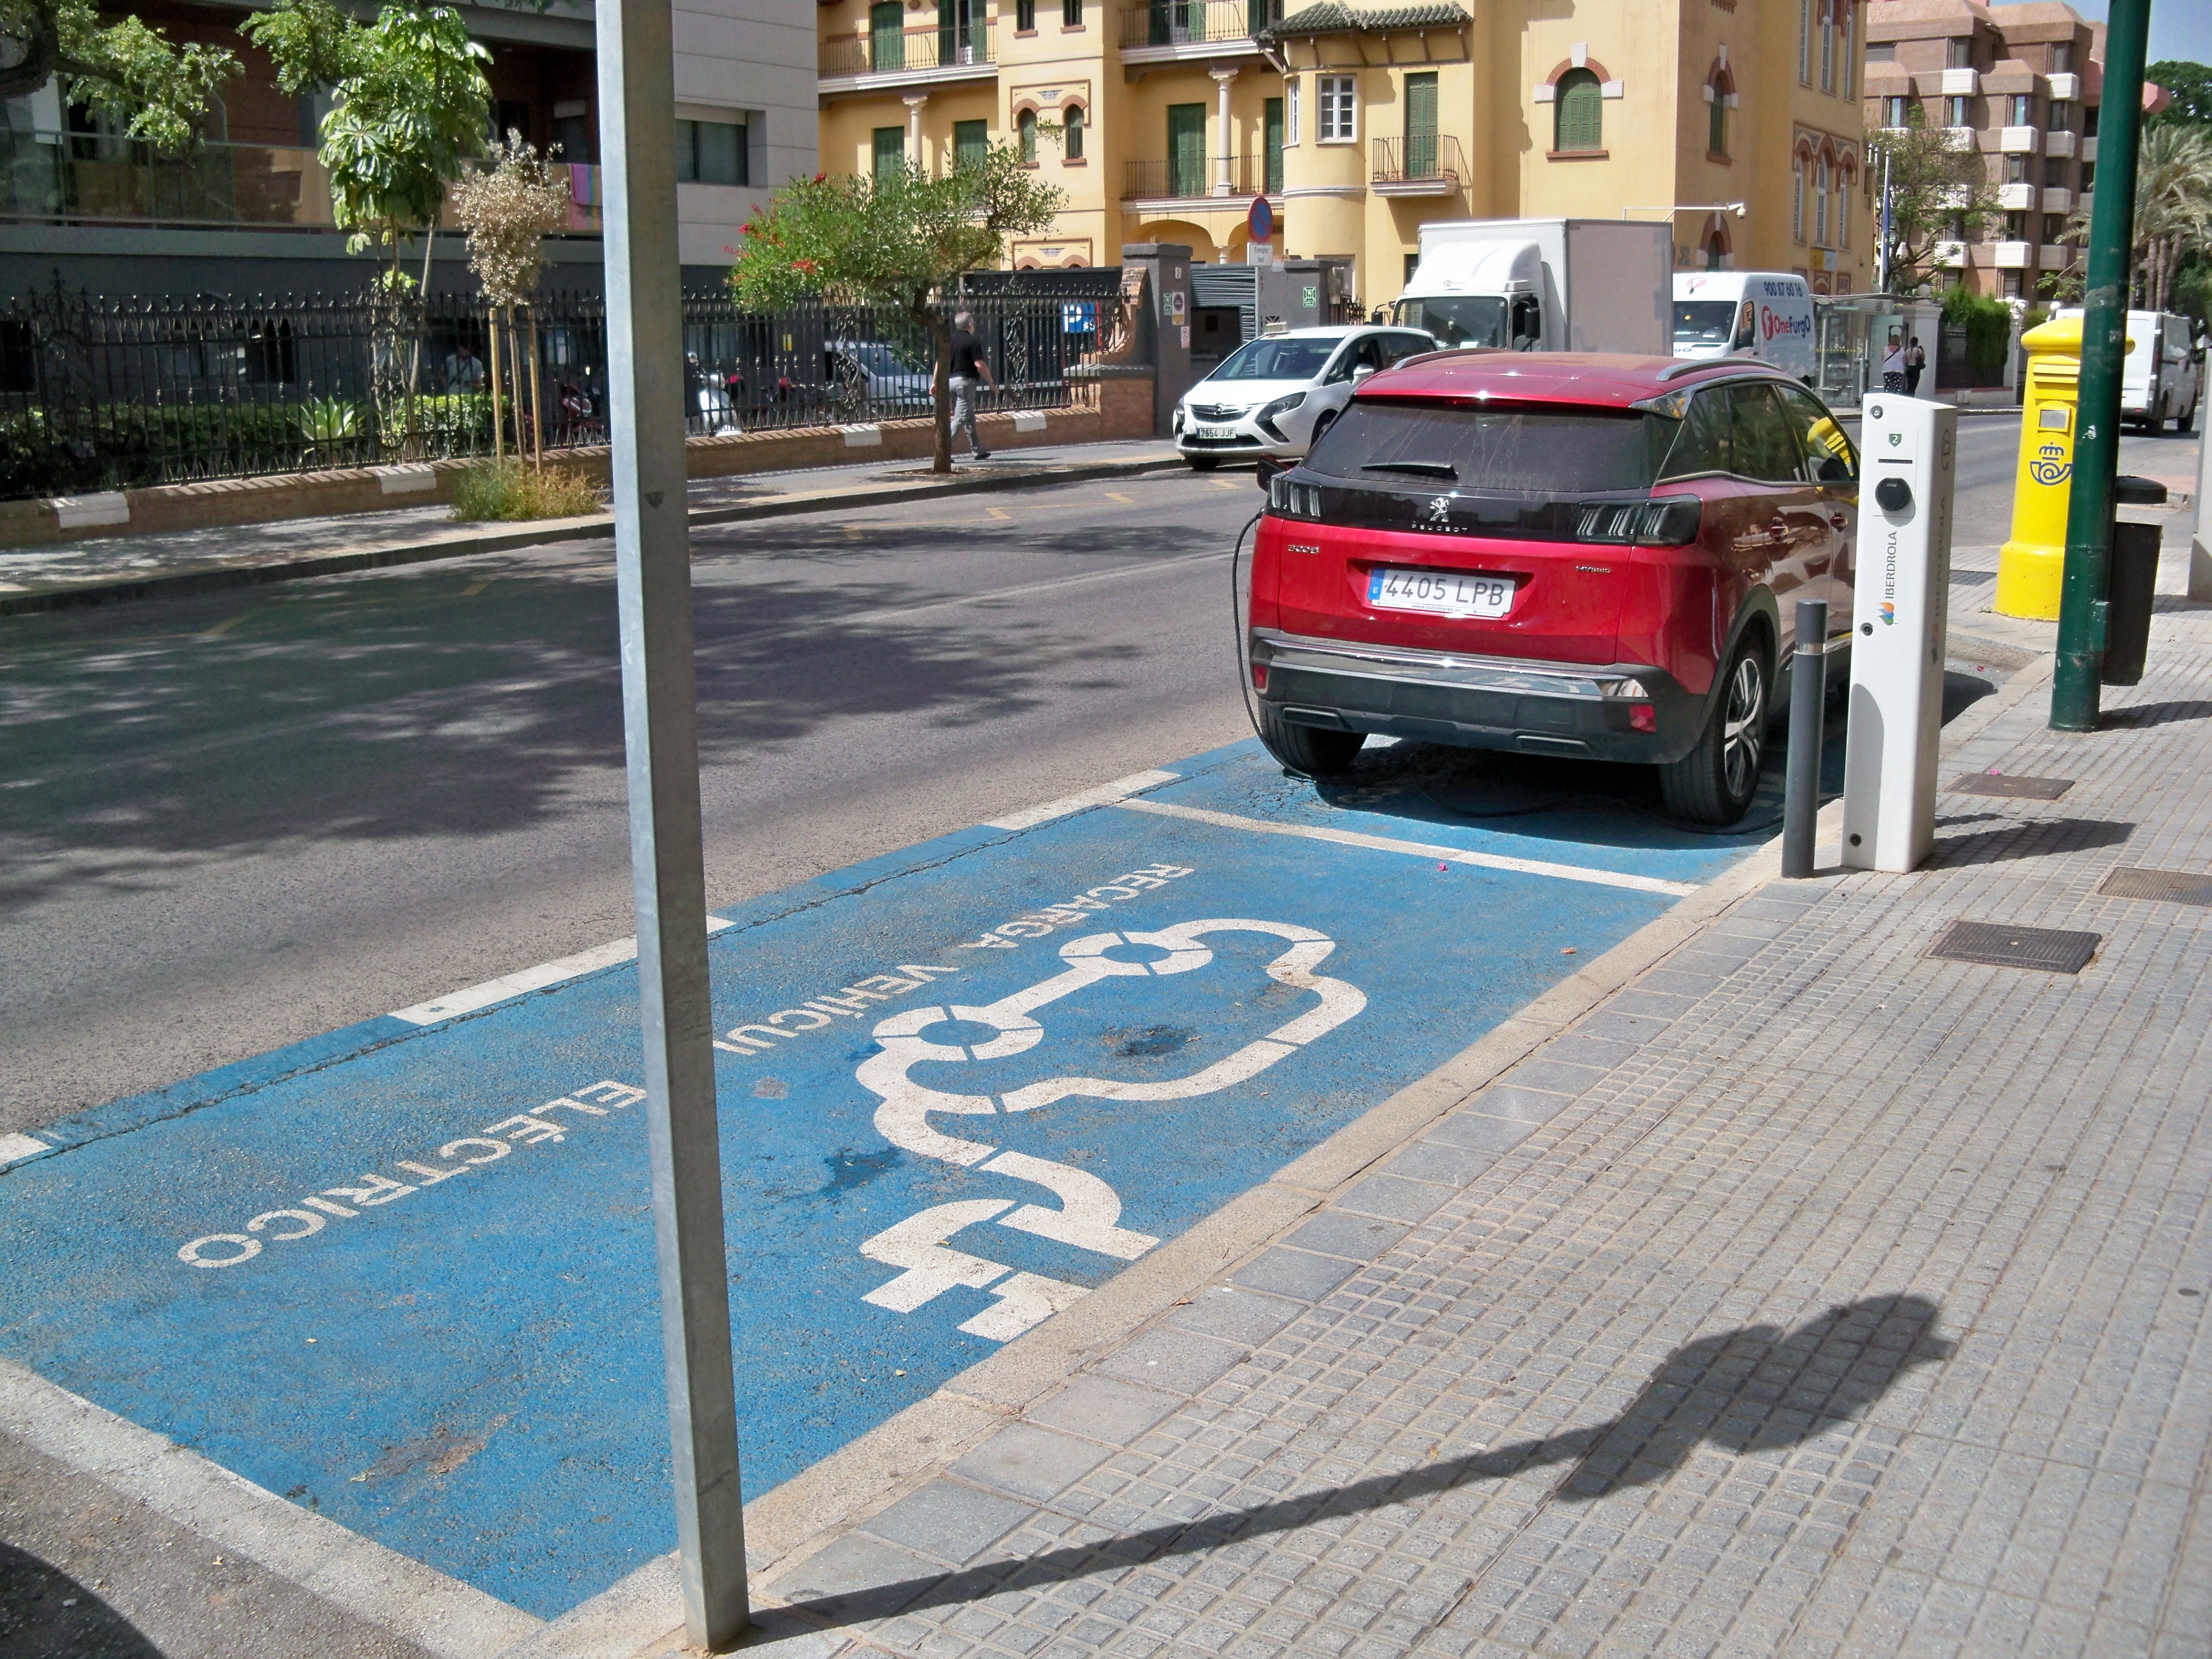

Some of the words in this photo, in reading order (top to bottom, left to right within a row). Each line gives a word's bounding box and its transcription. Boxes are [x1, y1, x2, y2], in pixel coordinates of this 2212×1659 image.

[1764, 281, 1777, 296] 900
[1777, 282, 1785, 296] 87
[1786, 282, 1794, 297] 60
[1794, 283, 1803, 297] 16
[1220, 429, 1234, 437] JJF
[1892, 435, 1898, 444] 2
[1411, 524, 1468, 533] PEUGEOT
[1288, 544, 1319, 554] 3008
[1885, 531, 1897, 599] IBERDROLA
[1385, 575, 1447, 601] 4405
[1455, 580, 1505, 607] LPB
[957, 863, 1195, 949] RECARGA
[178, 1079, 647, 1269] ELÉCTRICO
